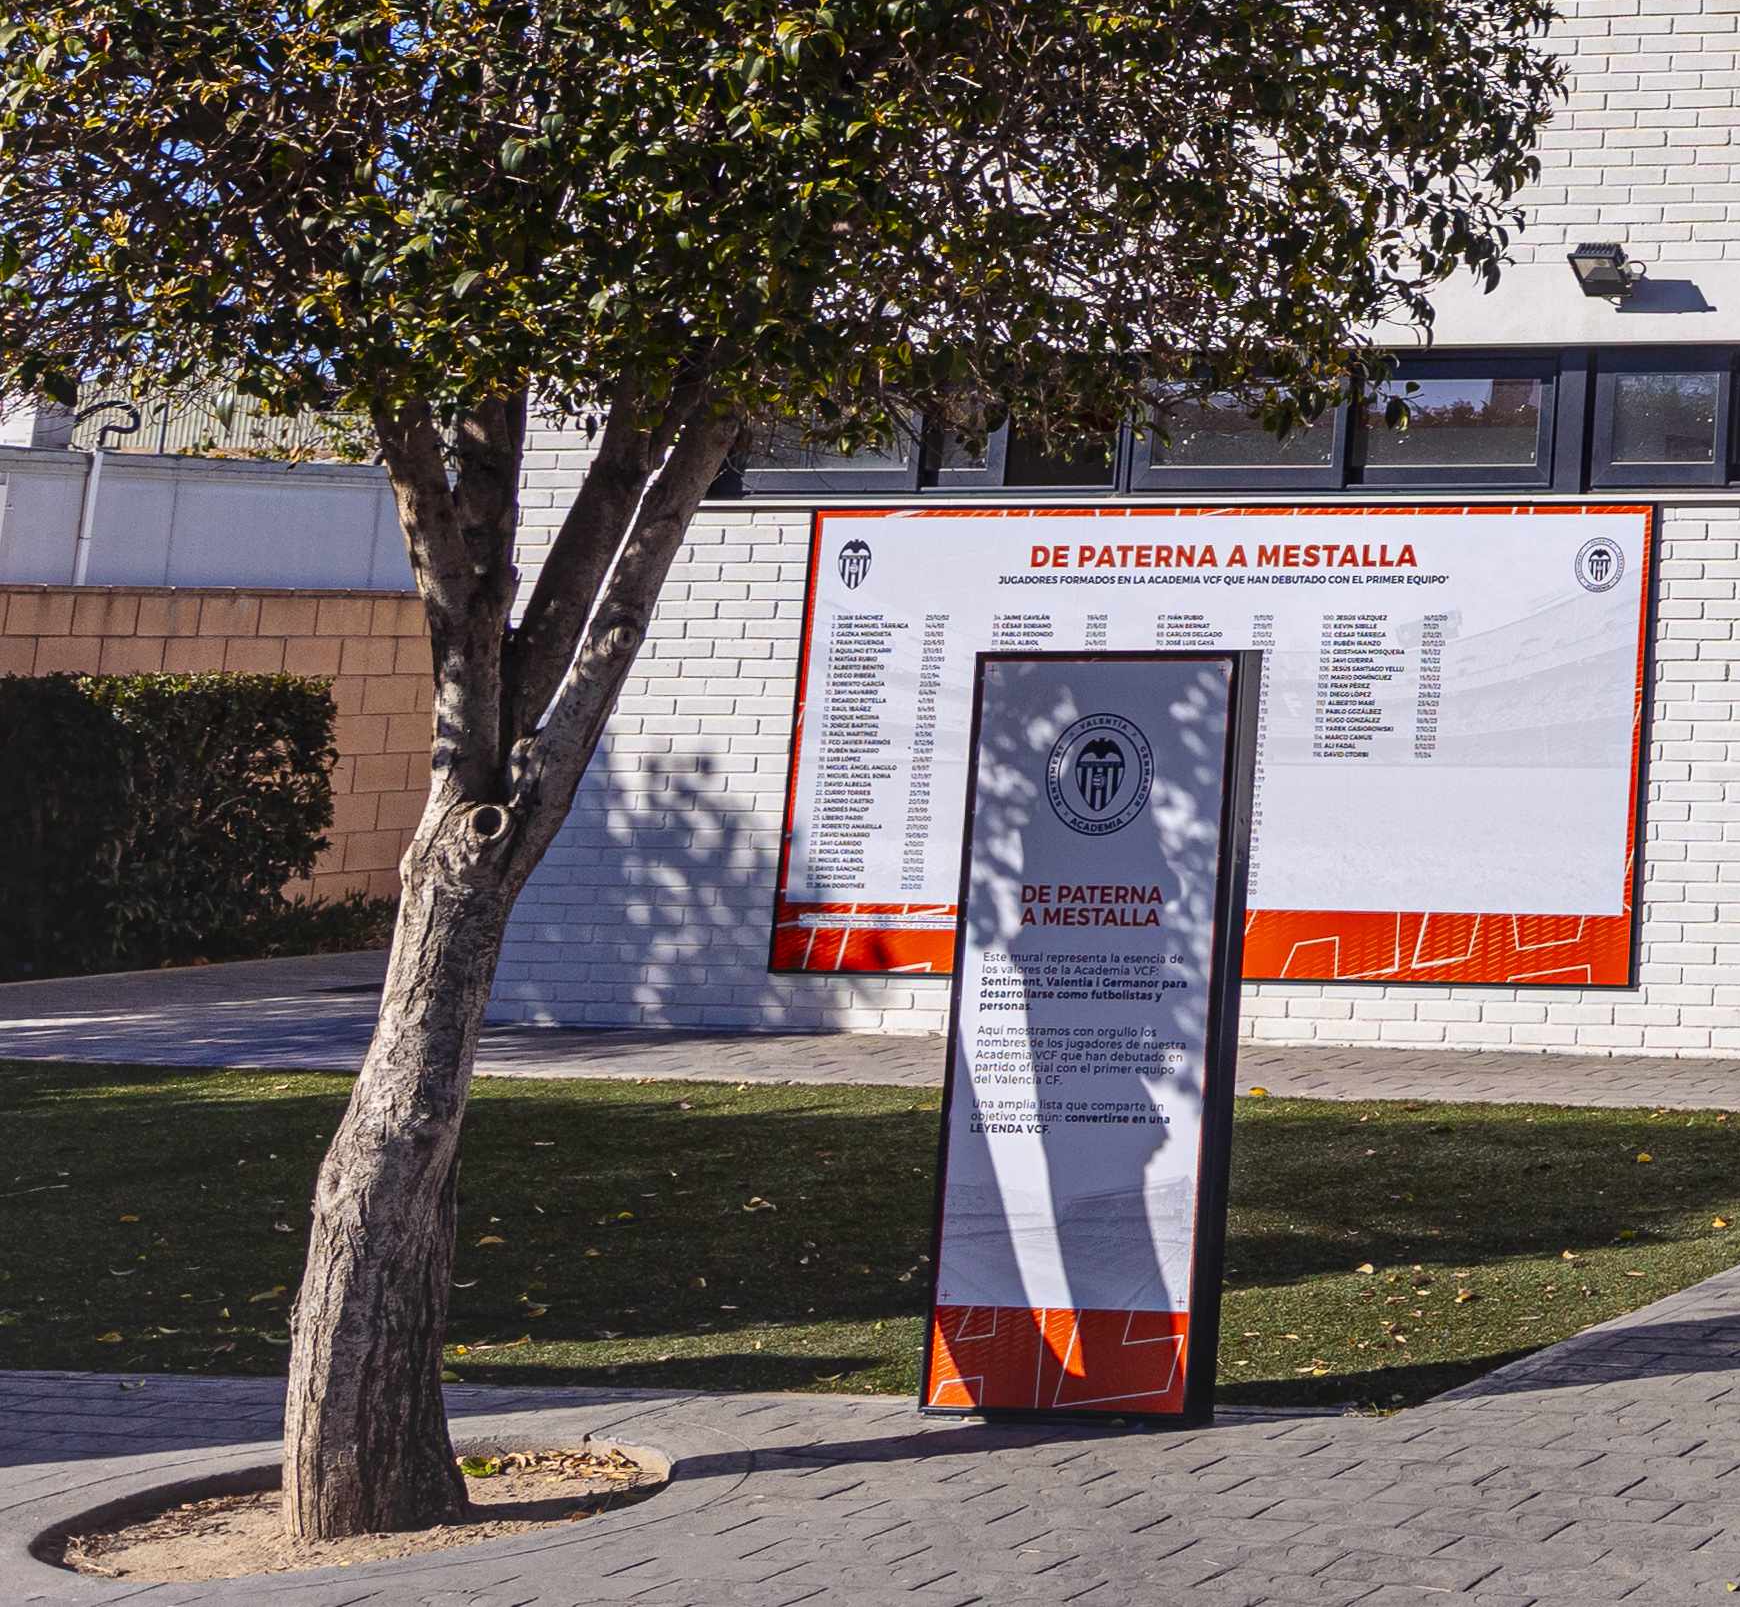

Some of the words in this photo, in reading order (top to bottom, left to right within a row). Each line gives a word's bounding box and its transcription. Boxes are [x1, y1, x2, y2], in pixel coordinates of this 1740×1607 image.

[1031, 545, 1069, 567] DE
[1078, 545, 1217, 567] PATERNA
[1227, 545, 1247, 566] A
[1257, 544, 1417, 566] MESTALLA
[998, 575, 1058, 583] JUGADORES
[1059, 575, 1116, 583] FORMADOS
[1117, 575, 1132, 583] EN
[1147, 575, 1201, 583] ACADEMIA
[1203, 575, 1222, 583] VCF
[1223, 575, 1245, 585] QUE
[1247, 575, 1270, 583] HAN
[1271, 575, 1327, 583] DEBUTADO
[1328, 575, 1350, 583] CON
[1352, 575, 1364, 583] EL
[1366, 575, 1405, 583] PRIMER
[1069, 817, 1124, 833] ACADEMIA
[1021, 885, 1051, 903] DE
[1057, 885, 1162, 904] PATERNA
[1021, 907, 1036, 925] A
[1043, 907, 1159, 926] MESTALLA
[983, 952, 1007, 961] Este
[1010, 953, 1043, 963] mural
[1046, 954, 1107, 964] representa
[1110, 953, 1120, 962] la
[1121, 953, 1166, 963] esencia
[1169, 954, 1184, 963] de
[982, 964, 998, 973] los
[1001, 964, 1041, 974] valores
[1043, 965, 1058, 974] de
[1061, 965, 1071, 974] la
[1073, 965, 1130, 975] Academia
[1134, 966, 1159, 977] VCF:
[981, 976, 1043, 986] Sentiment,
[1096, 977, 1100, 987] i
[1102, 978, 1160, 987] Germanor
[1162, 980, 1187, 989] para
[980, 988, 1055, 998] desarrollarse
[1056, 991, 1088, 999] como
[1091, 990, 1153, 1000] futbolistas
[1155, 992, 1162, 1002] y
[979, 1002, 1033, 1011] personas.
[977, 1025, 1004, 1035] Aquí
[1006, 1027, 1071, 1035] mostramos
[1073, 1028, 1094, 1036] con
[1097, 1026, 1138, 1039] orgullo
[1140, 1027, 1157, 1036] los
[970, 1123, 1024, 1133] LEYENDA
[1026, 1124, 1050, 1133] VCF.
